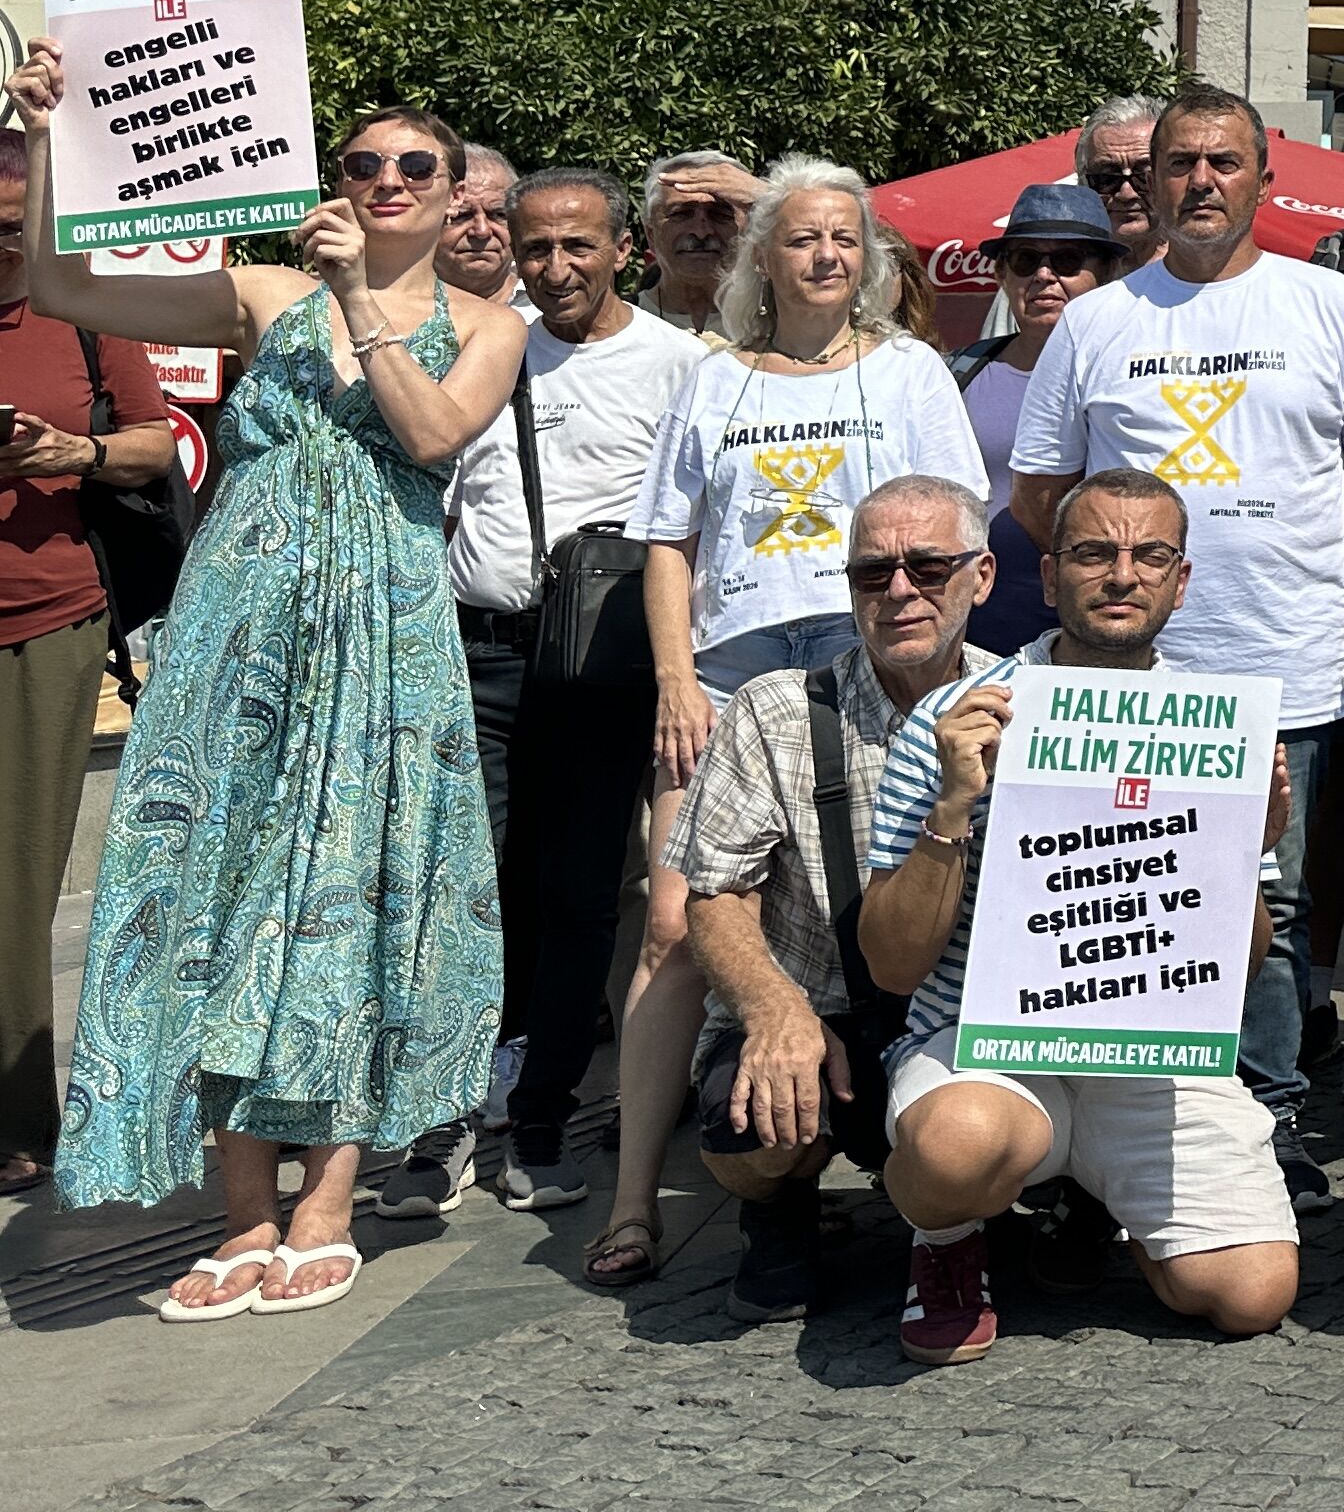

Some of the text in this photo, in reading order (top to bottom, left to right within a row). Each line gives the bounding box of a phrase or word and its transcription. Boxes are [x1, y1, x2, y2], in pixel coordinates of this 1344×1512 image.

[104, 18, 219, 68] engelli
[88, 45, 256, 108] hakları ve
[109, 75, 257, 135] engelleri
[131, 113, 253, 163] birlikte
[117, 135, 290, 202] aşmak için
[72, 201, 306, 244] ORTAK MÜCADELEYE KATIL!
[1129, 352, 1249, 379] HALKLARIN
[1248, 360, 1285, 371] ZİRVESİ
[723, 420, 846, 452] HALKLARIN
[1050, 688, 1237, 729] HALKLARIN
[1027, 726, 1247, 779] İKLİM ZİRVESİ
[1118, 779, 1147, 807] İLE
[1019, 808, 1198, 859] toplumsal
[1046, 849, 1178, 892] cinsiyet
[1027, 888, 1202, 936] eşitliği ve
[1060, 924, 1175, 969] LGBTİ+
[1019, 959, 1221, 1014] hakları için
[972, 1036, 1222, 1068] ORTAK MÜCADELEYE KATIL!
